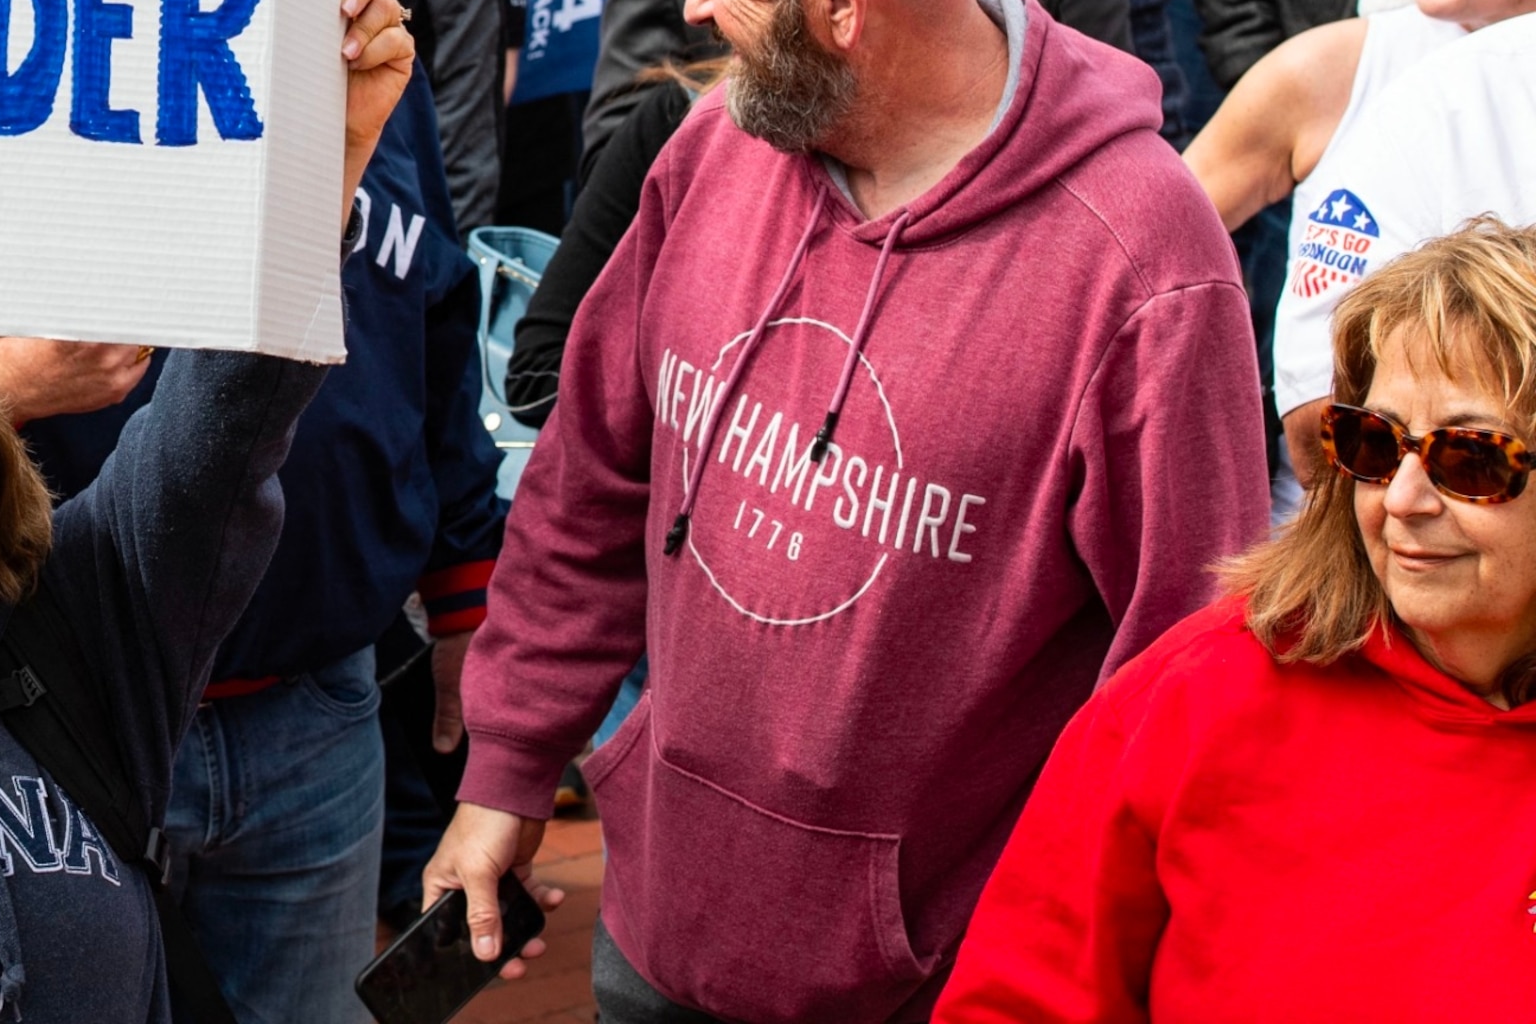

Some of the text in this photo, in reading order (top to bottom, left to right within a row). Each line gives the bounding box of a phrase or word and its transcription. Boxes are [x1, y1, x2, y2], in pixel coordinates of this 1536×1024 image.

[1343, 232, 1371, 254] GO
[656, 348, 986, 563] NEW HAMPSHIRE
[733, 500, 804, 561] 1776
